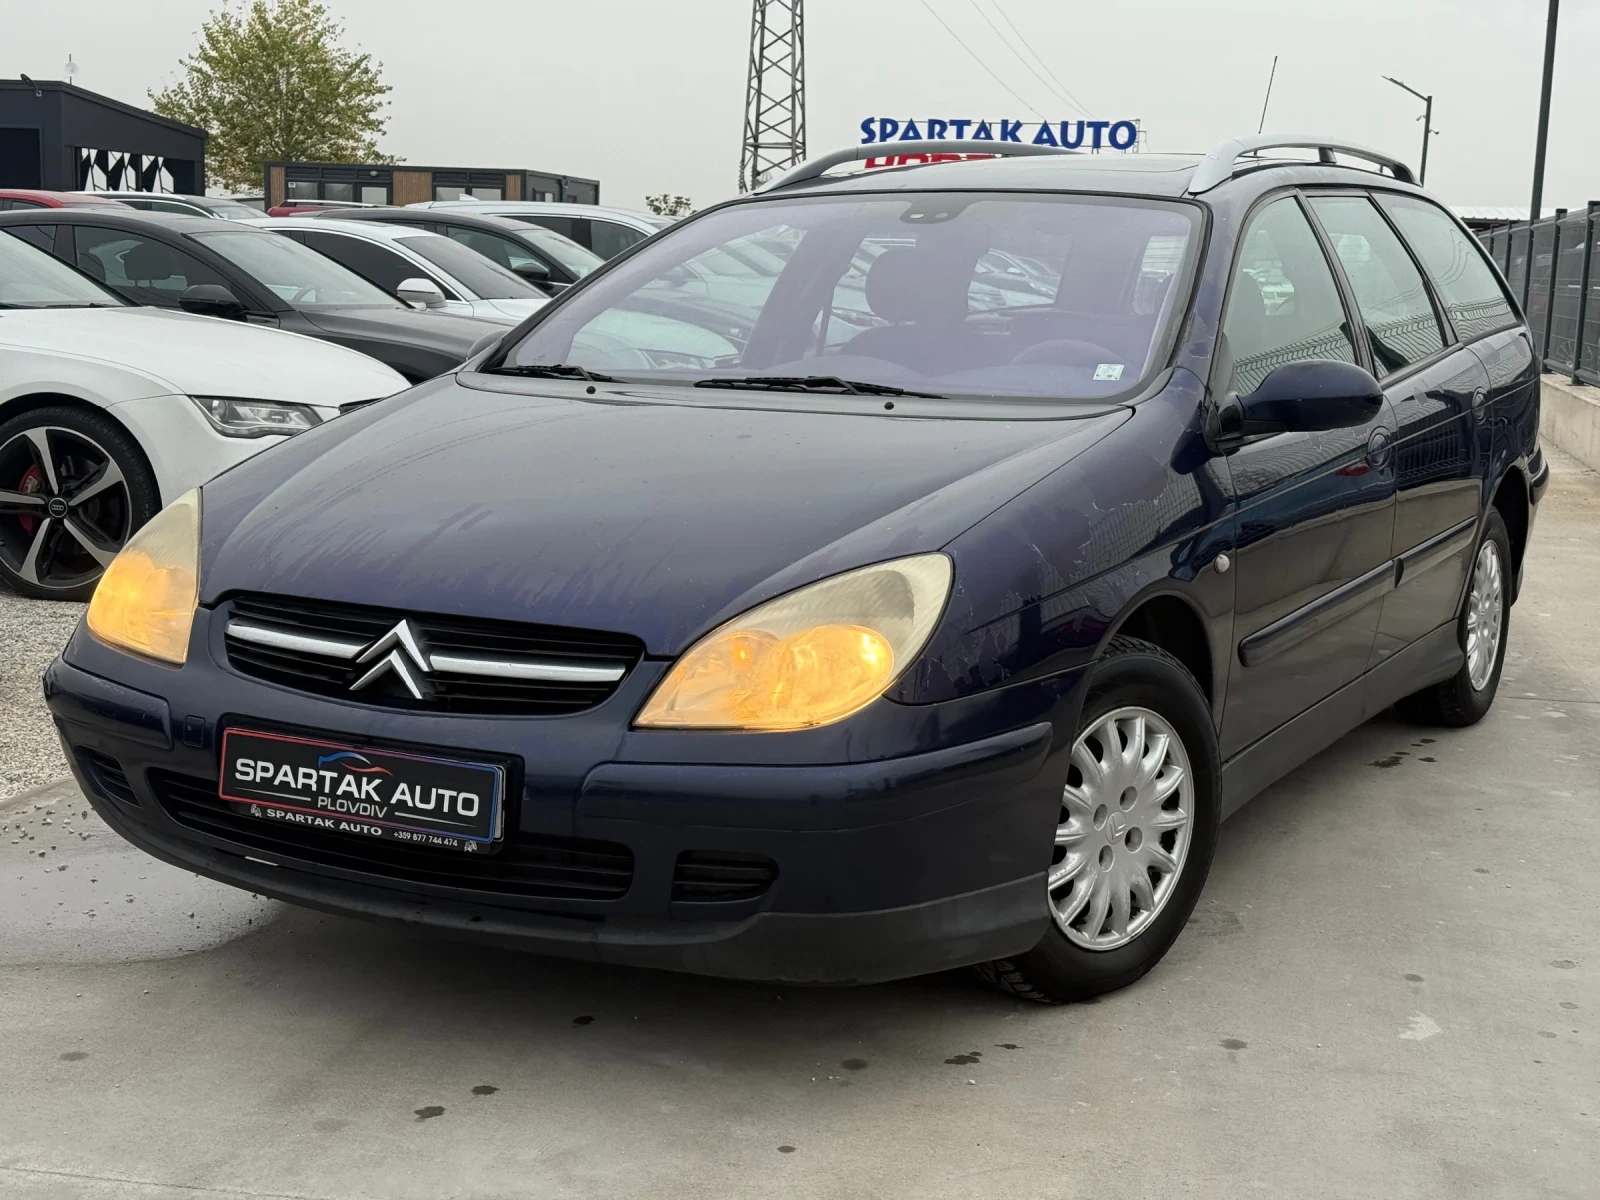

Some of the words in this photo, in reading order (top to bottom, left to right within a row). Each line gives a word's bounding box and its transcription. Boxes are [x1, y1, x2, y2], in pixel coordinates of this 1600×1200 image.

[860, 117, 1024, 144] SPARTAK
[1032, 120, 1138, 149] AUTO
[235, 758, 383, 802] SPARTAK
[390, 783, 480, 817] AUTO
[317, 796, 388, 818] PLOVDIV
[266, 808, 335, 829] SPARTAK
[339, 822, 383, 836] AUTO
[394, 831, 411, 839] +359
[412, 833, 427, 842] 877
[428, 836, 442, 844] 744
[443, 838, 458, 846] 474
